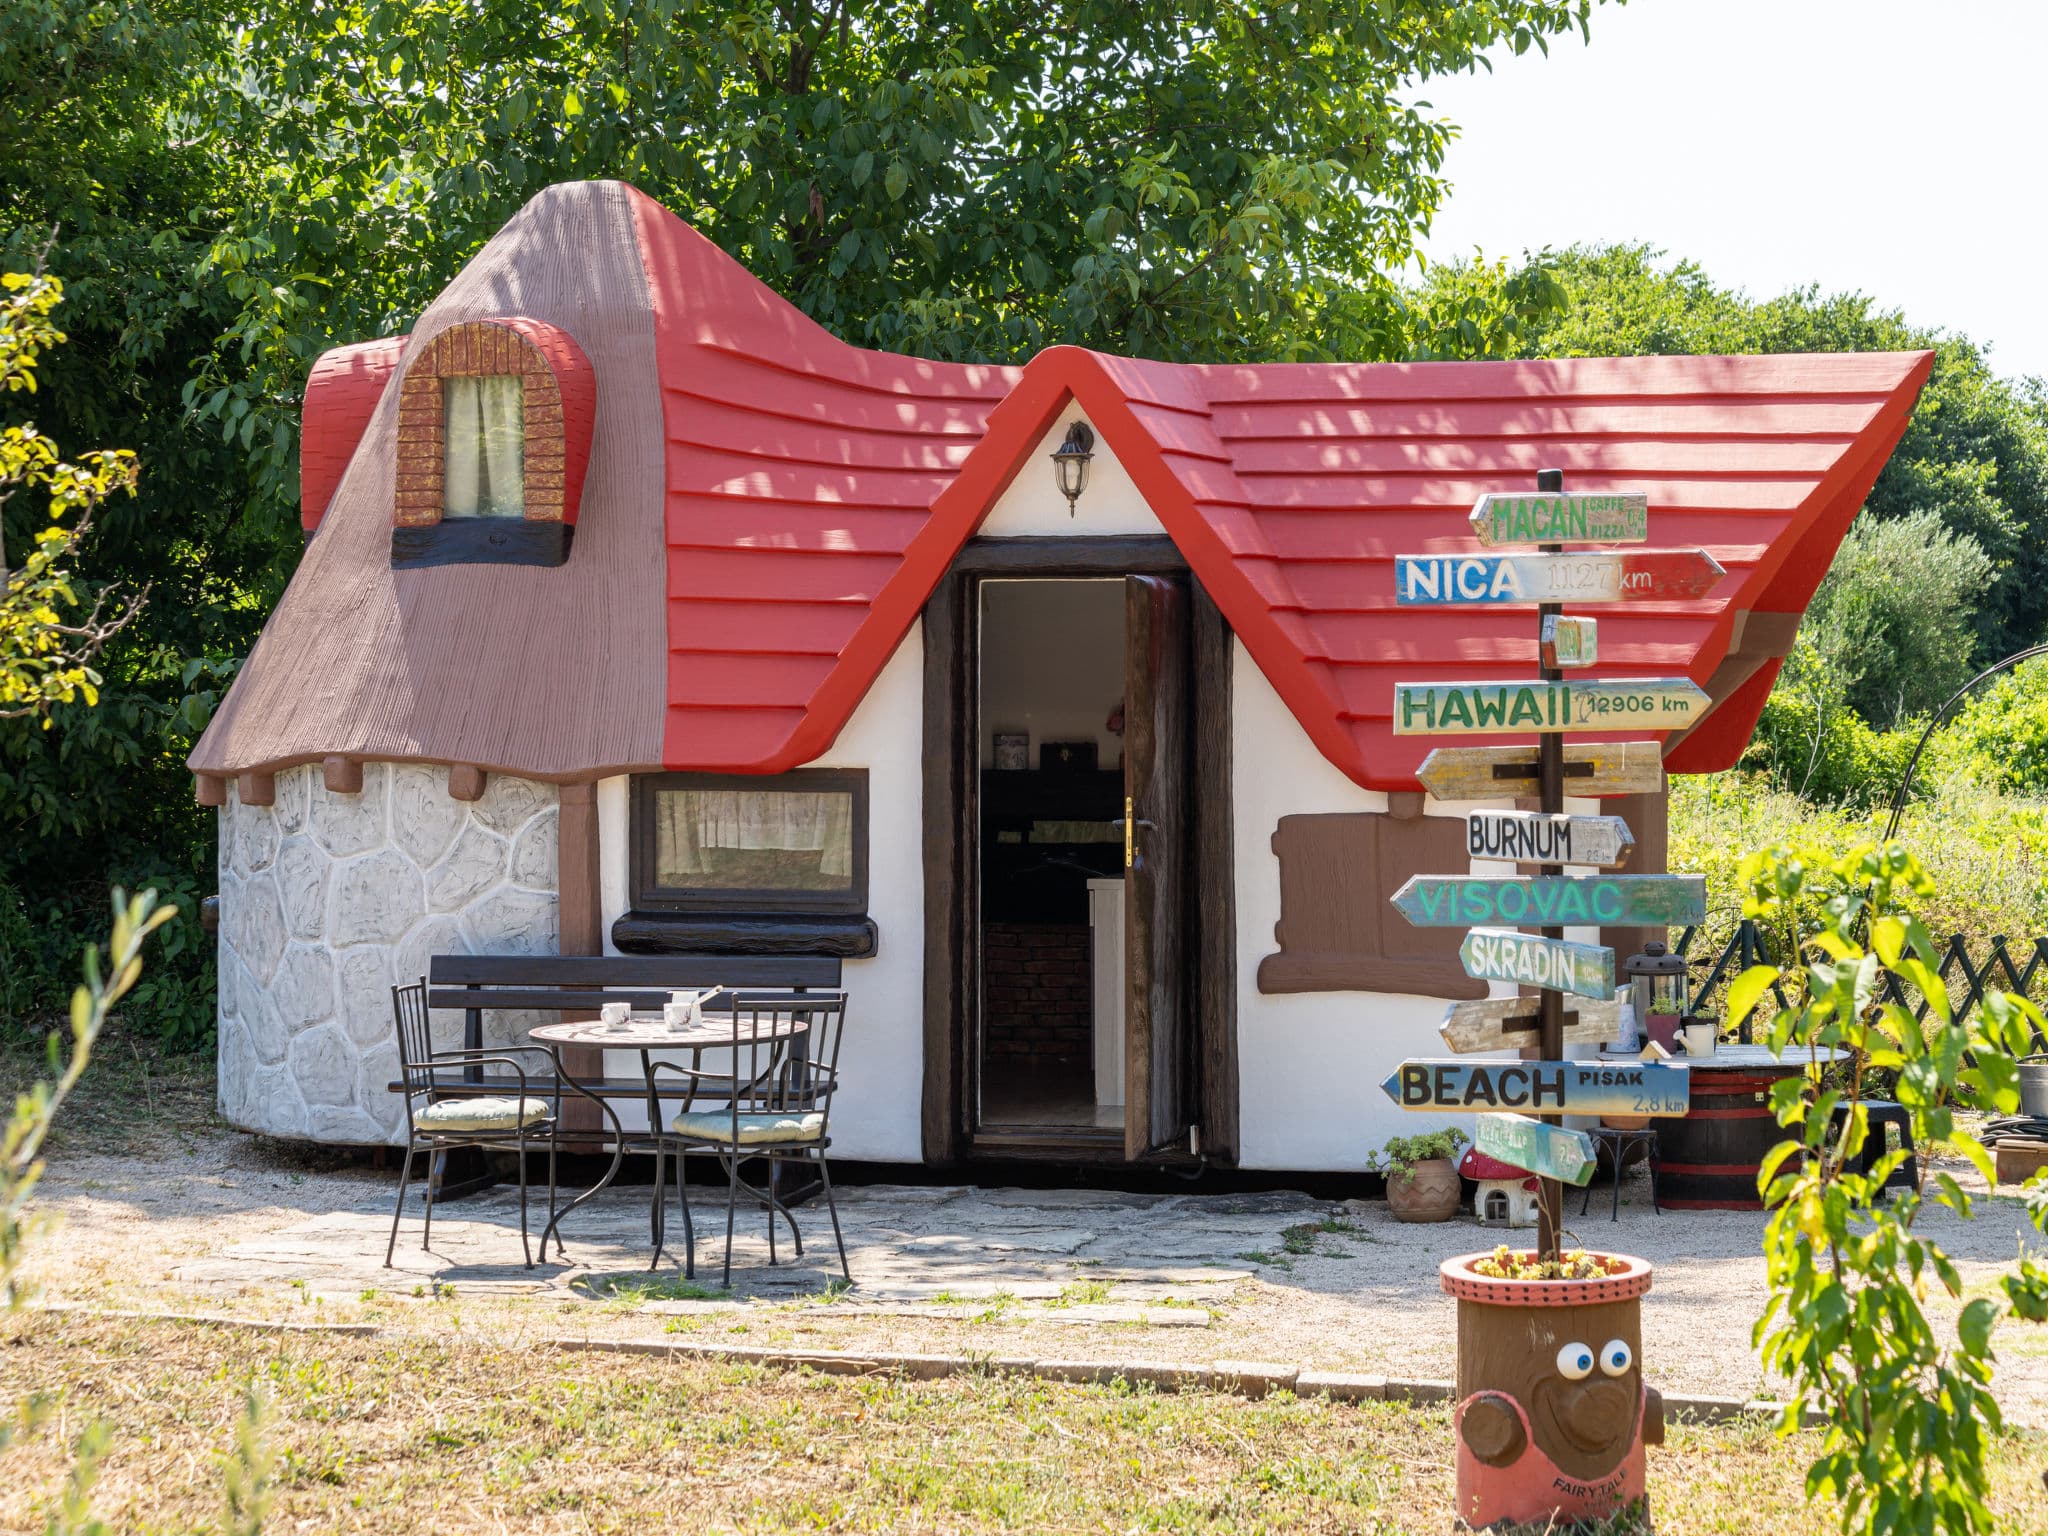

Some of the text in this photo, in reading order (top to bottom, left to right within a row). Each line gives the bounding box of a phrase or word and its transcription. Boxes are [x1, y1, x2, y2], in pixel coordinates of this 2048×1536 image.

[1493, 498, 1588, 541] MACAN
[1590, 497, 1624, 511] CAFFE
[1591, 525, 1626, 539] PIZZA
[1406, 559, 1652, 600] NICA 1127 km
[1403, 686, 1689, 728] HAWAII 12906 km
[1470, 815, 1572, 861] BURNUM
[1416, 881, 1623, 922] VISOVAC
[1470, 935, 1576, 990] SKRADIN
[1402, 1066, 1566, 1107] BEACH
[1579, 1072, 1644, 1086] PISAK
[1633, 1094, 1686, 1113] 2,8 km
[1553, 1477, 1595, 1498] FAIRY
